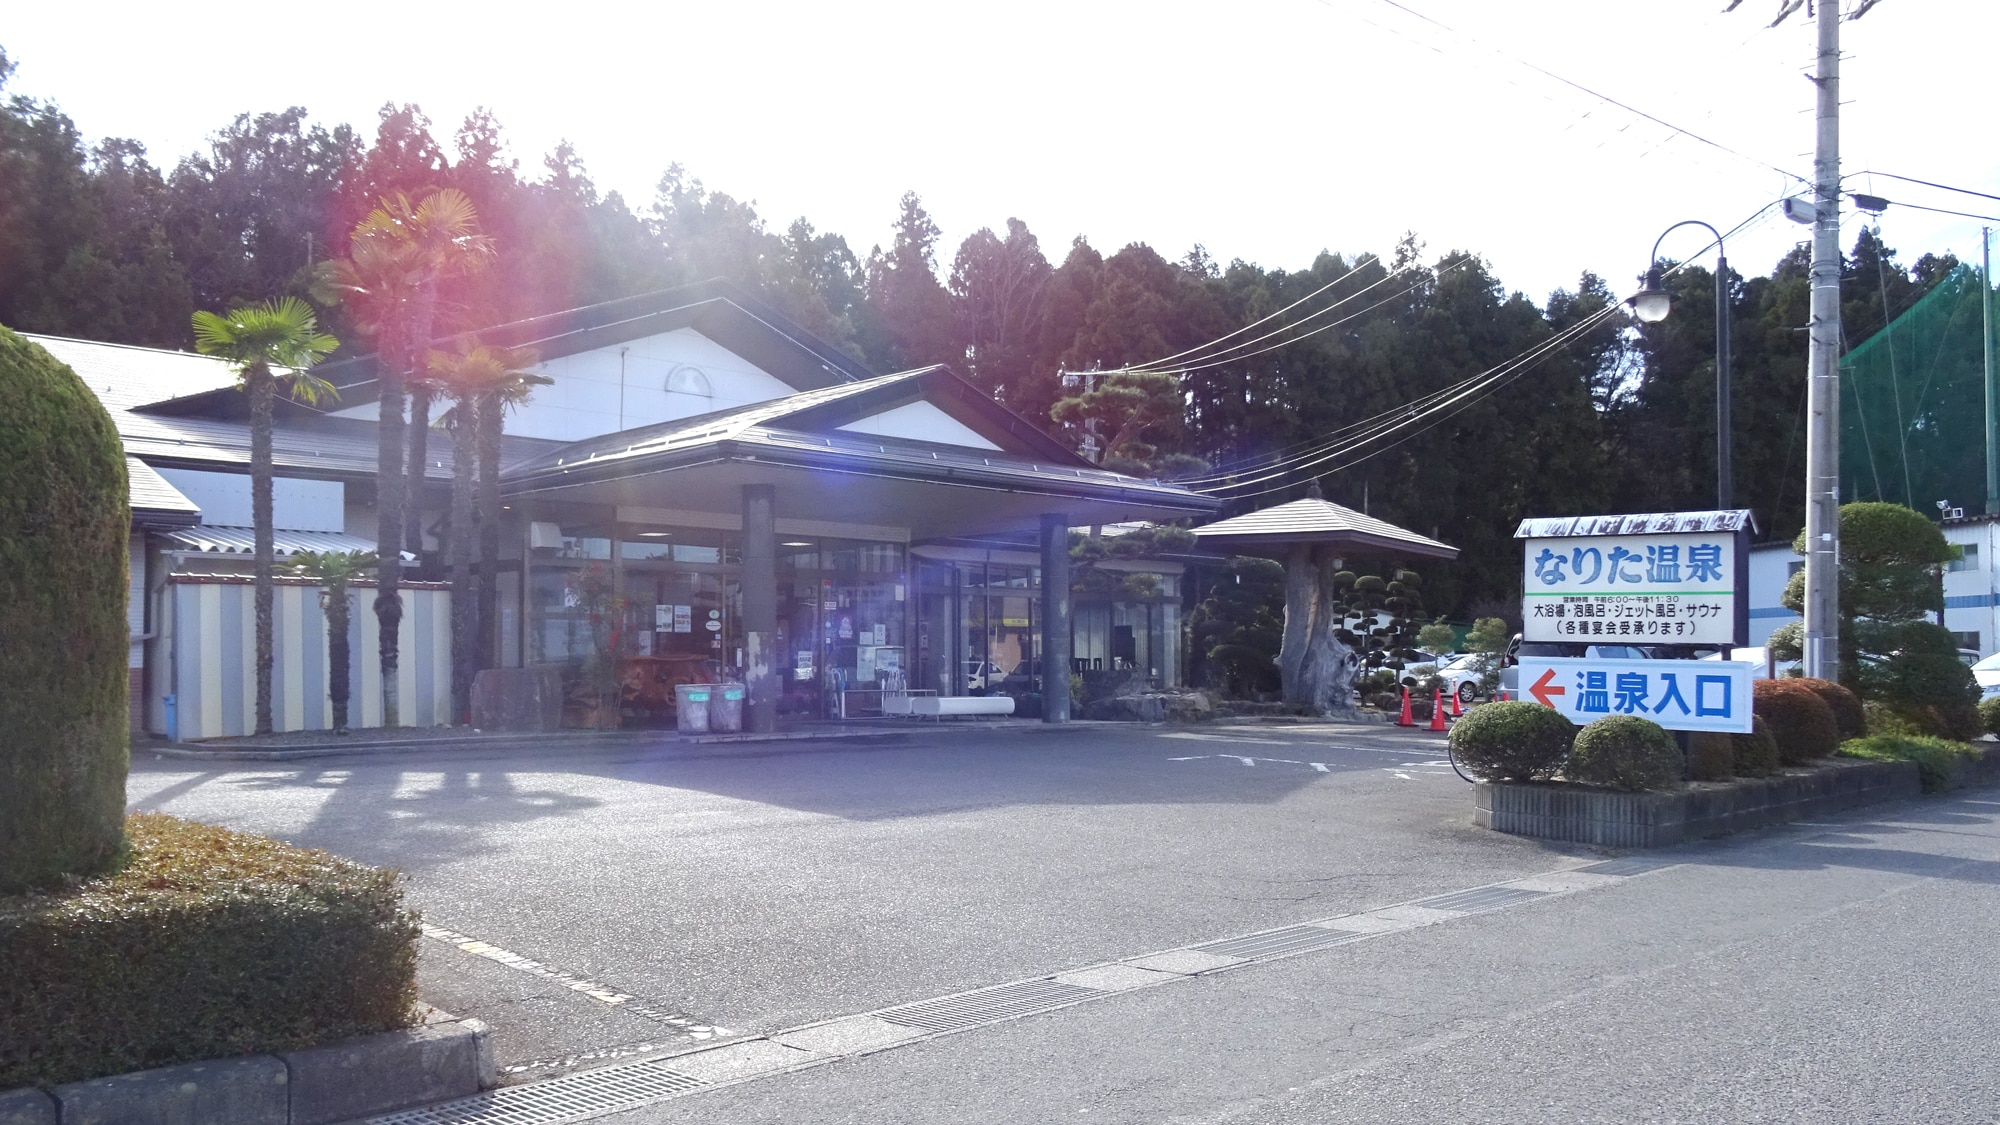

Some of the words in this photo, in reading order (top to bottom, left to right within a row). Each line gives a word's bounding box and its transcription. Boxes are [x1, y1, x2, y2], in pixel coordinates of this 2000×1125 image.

[1534, 543, 1723, 585] なりた温泉
[1574, 670, 1732, 718] 温泉入口
